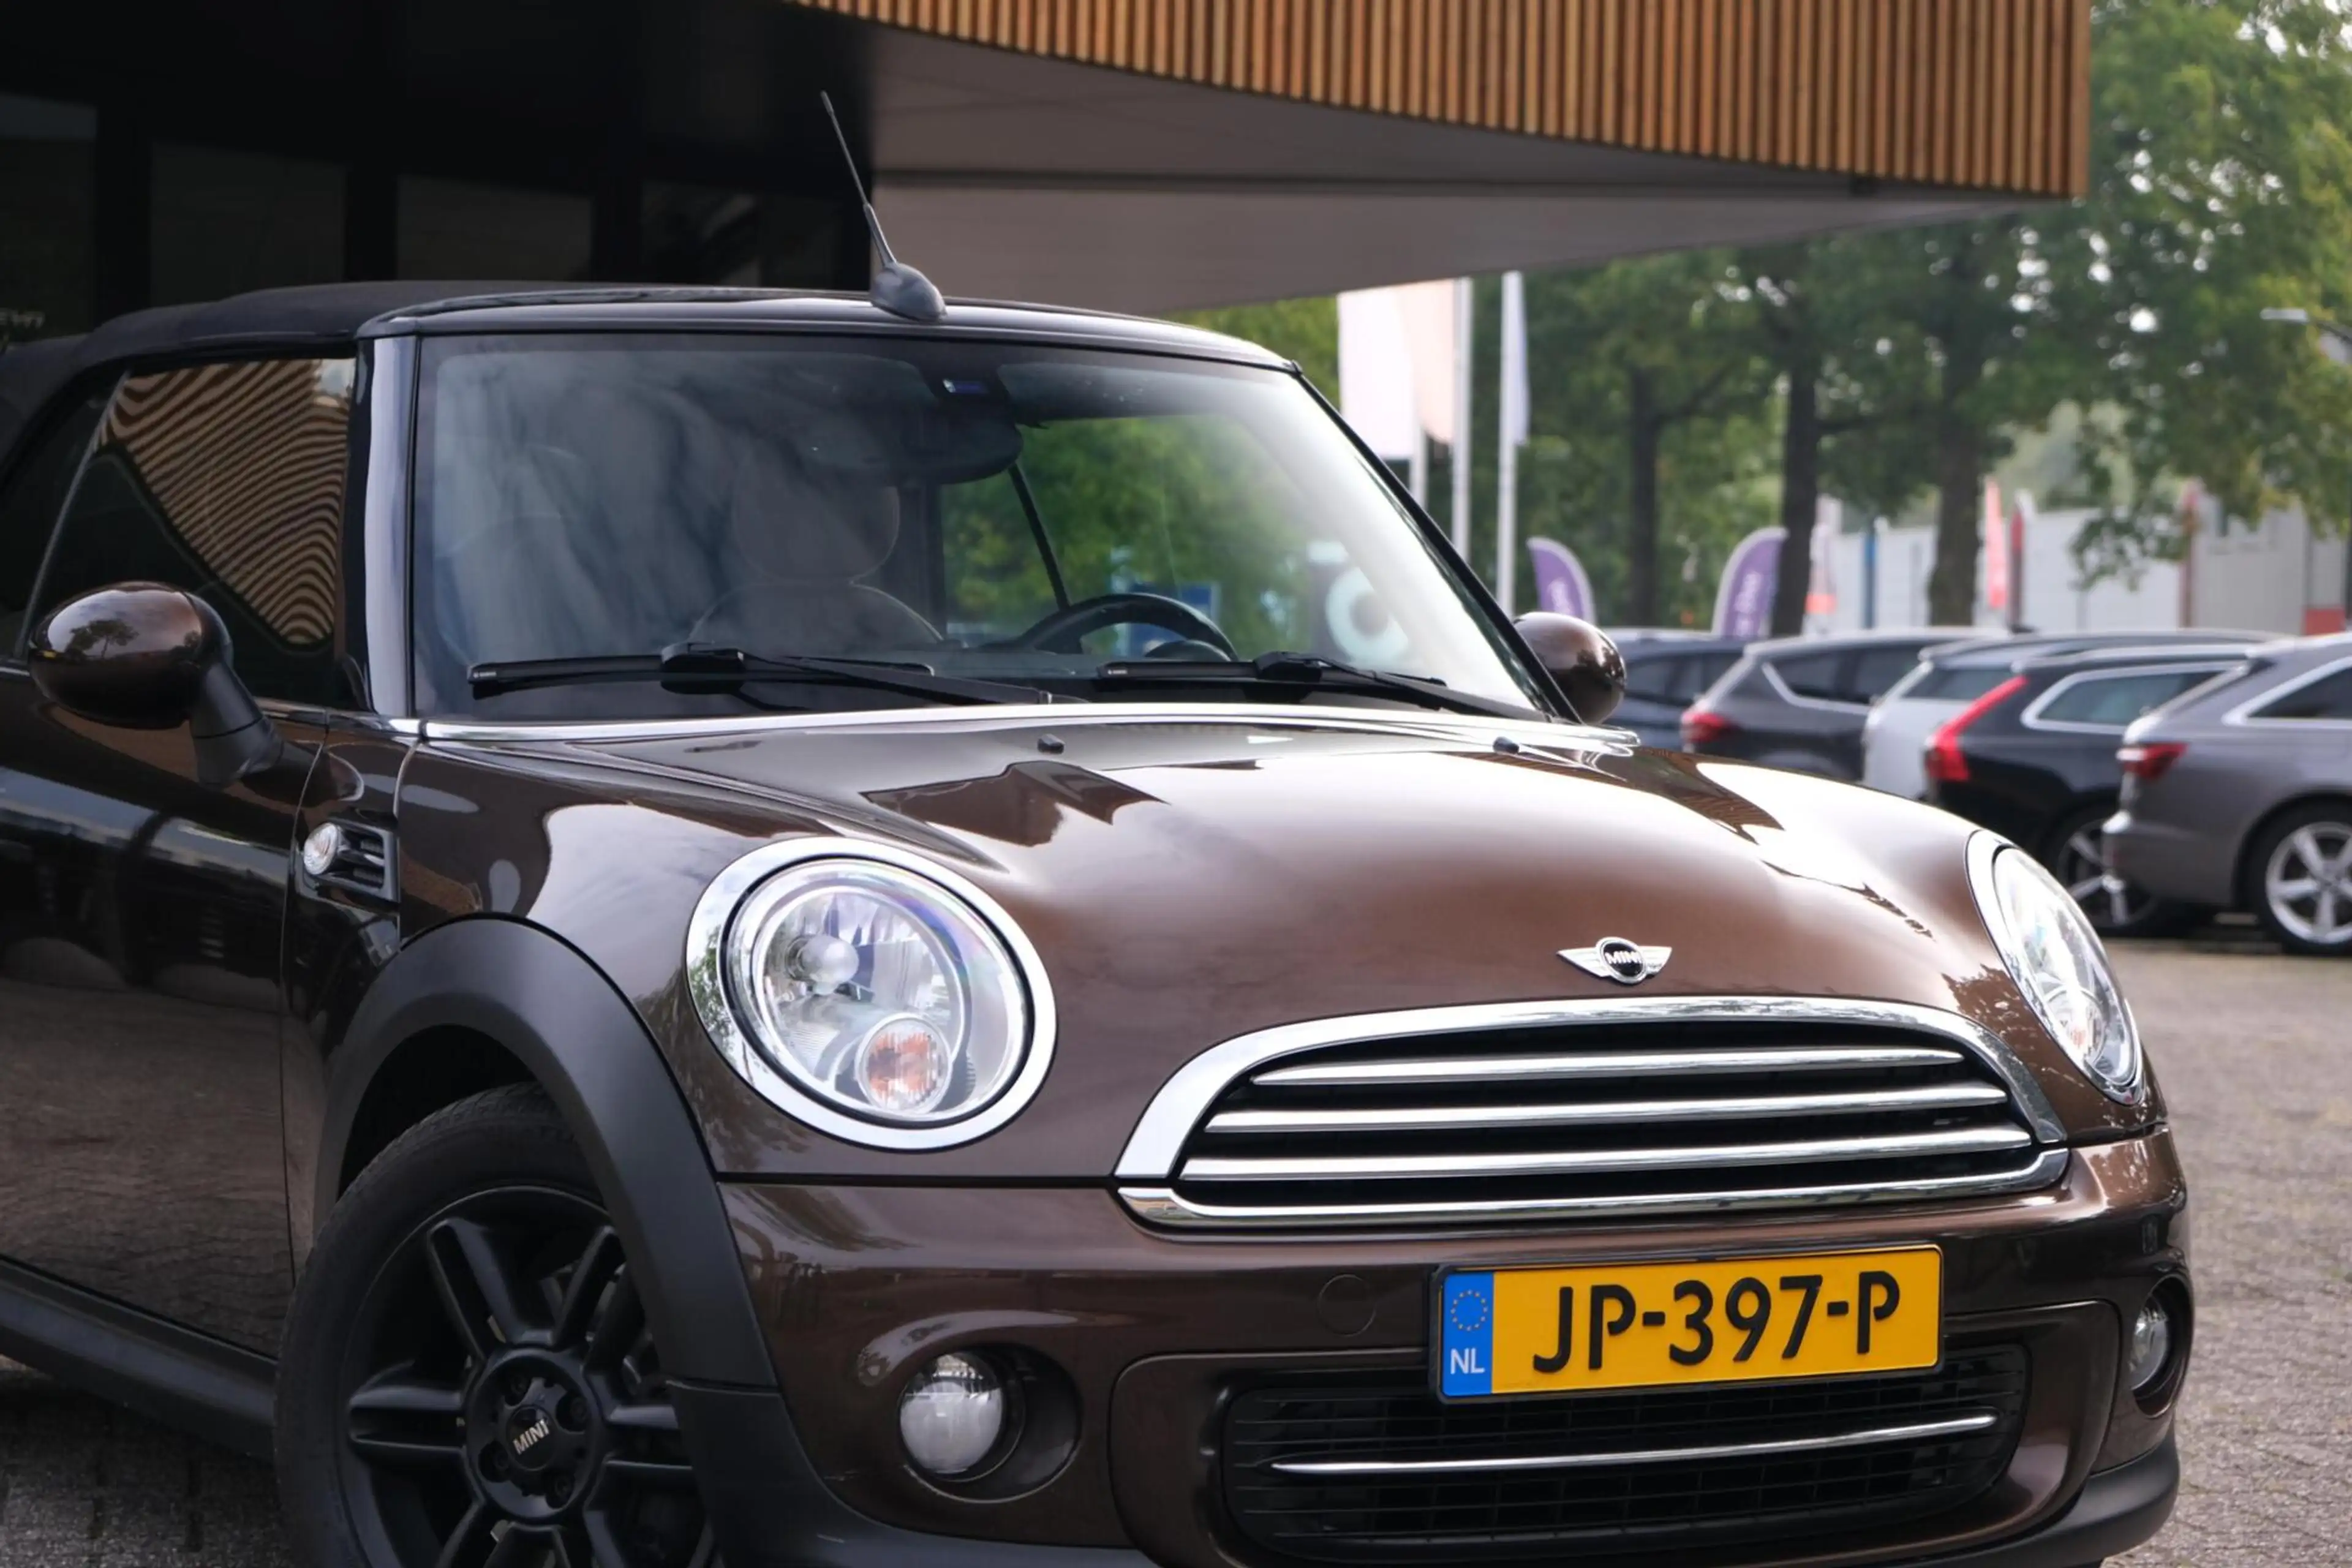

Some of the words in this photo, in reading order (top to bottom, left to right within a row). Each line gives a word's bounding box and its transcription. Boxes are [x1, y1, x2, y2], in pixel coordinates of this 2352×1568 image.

[1532, 1270, 1901, 1373] JP-397-P
[1450, 1348, 1485, 1375] NL
[513, 1419, 549, 1455] MINI
